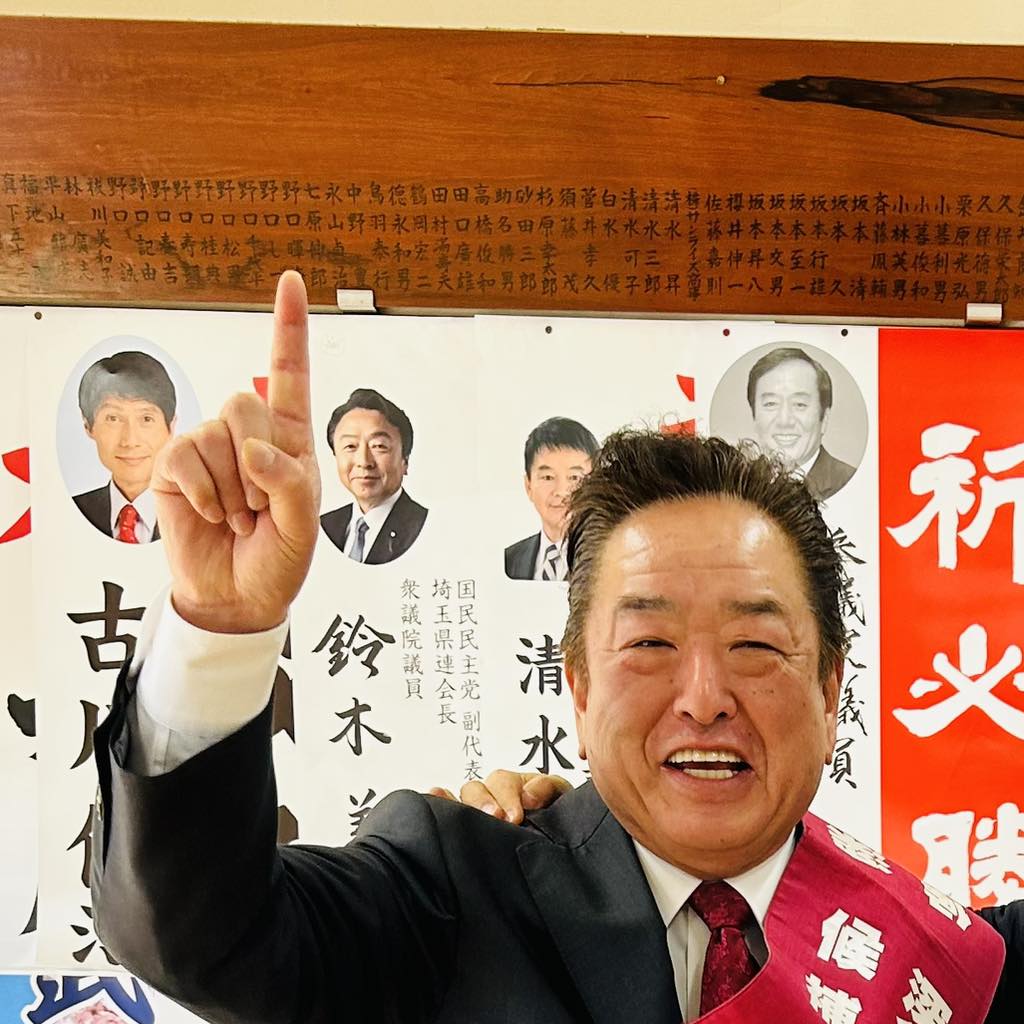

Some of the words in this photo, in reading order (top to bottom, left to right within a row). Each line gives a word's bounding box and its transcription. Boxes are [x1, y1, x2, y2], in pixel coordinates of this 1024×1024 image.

[400, 577, 425, 701] 衆議院議員
[432, 578, 458, 725] 埼玉県連会長
[456, 578, 482, 701] 国民民主党
[462, 709, 485, 782] 副代表
[515, 634, 576, 775] 清水
